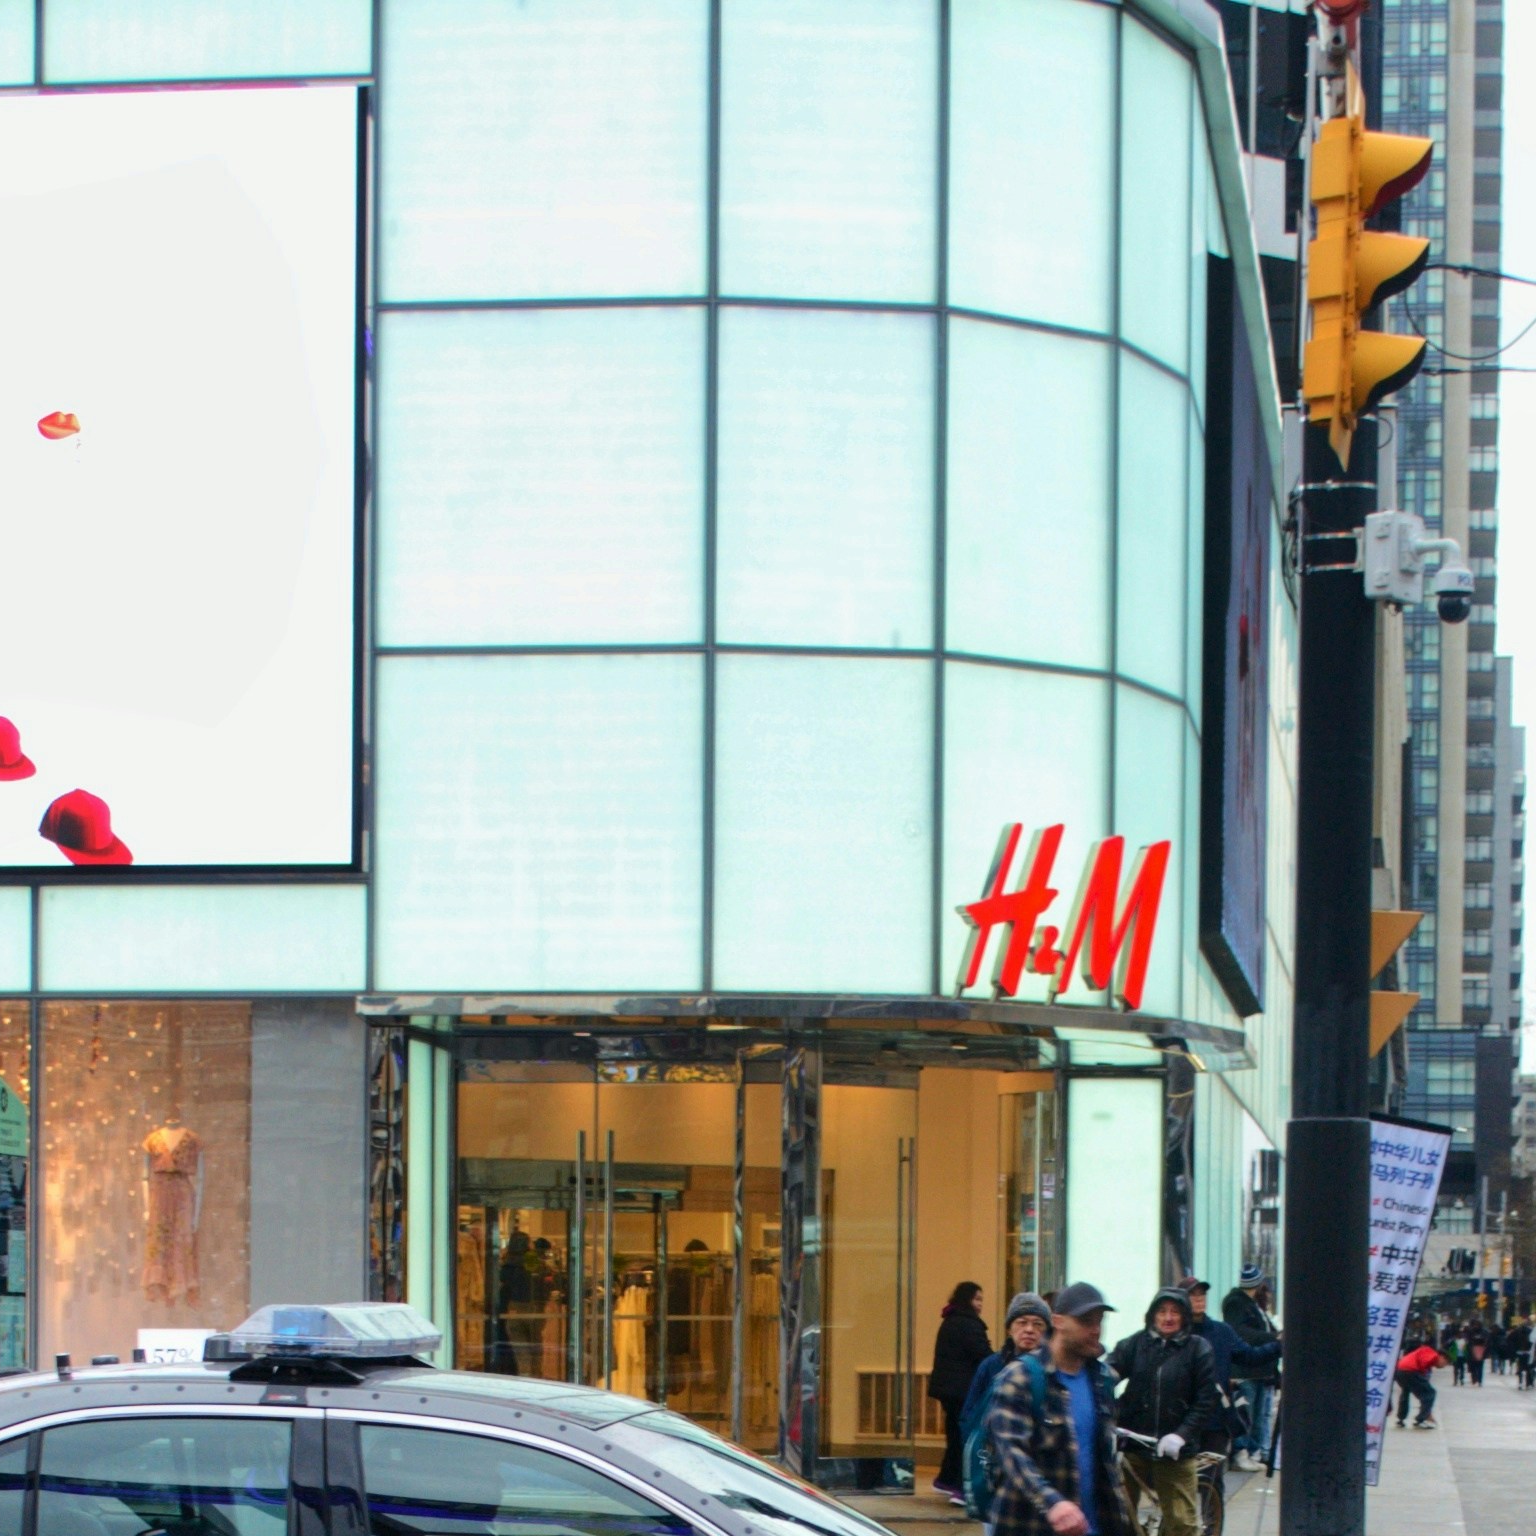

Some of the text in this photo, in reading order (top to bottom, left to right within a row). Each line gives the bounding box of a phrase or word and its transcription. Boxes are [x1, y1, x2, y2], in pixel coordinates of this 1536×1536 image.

[960, 821, 1172, 1011] H&M
[1370, 1162, 1435, 1190] 马列子孙
[1382, 1196, 1429, 1217] Chinese
[1398, 1219, 1425, 1239] Party
[1381, 1244, 1419, 1266] 中共
